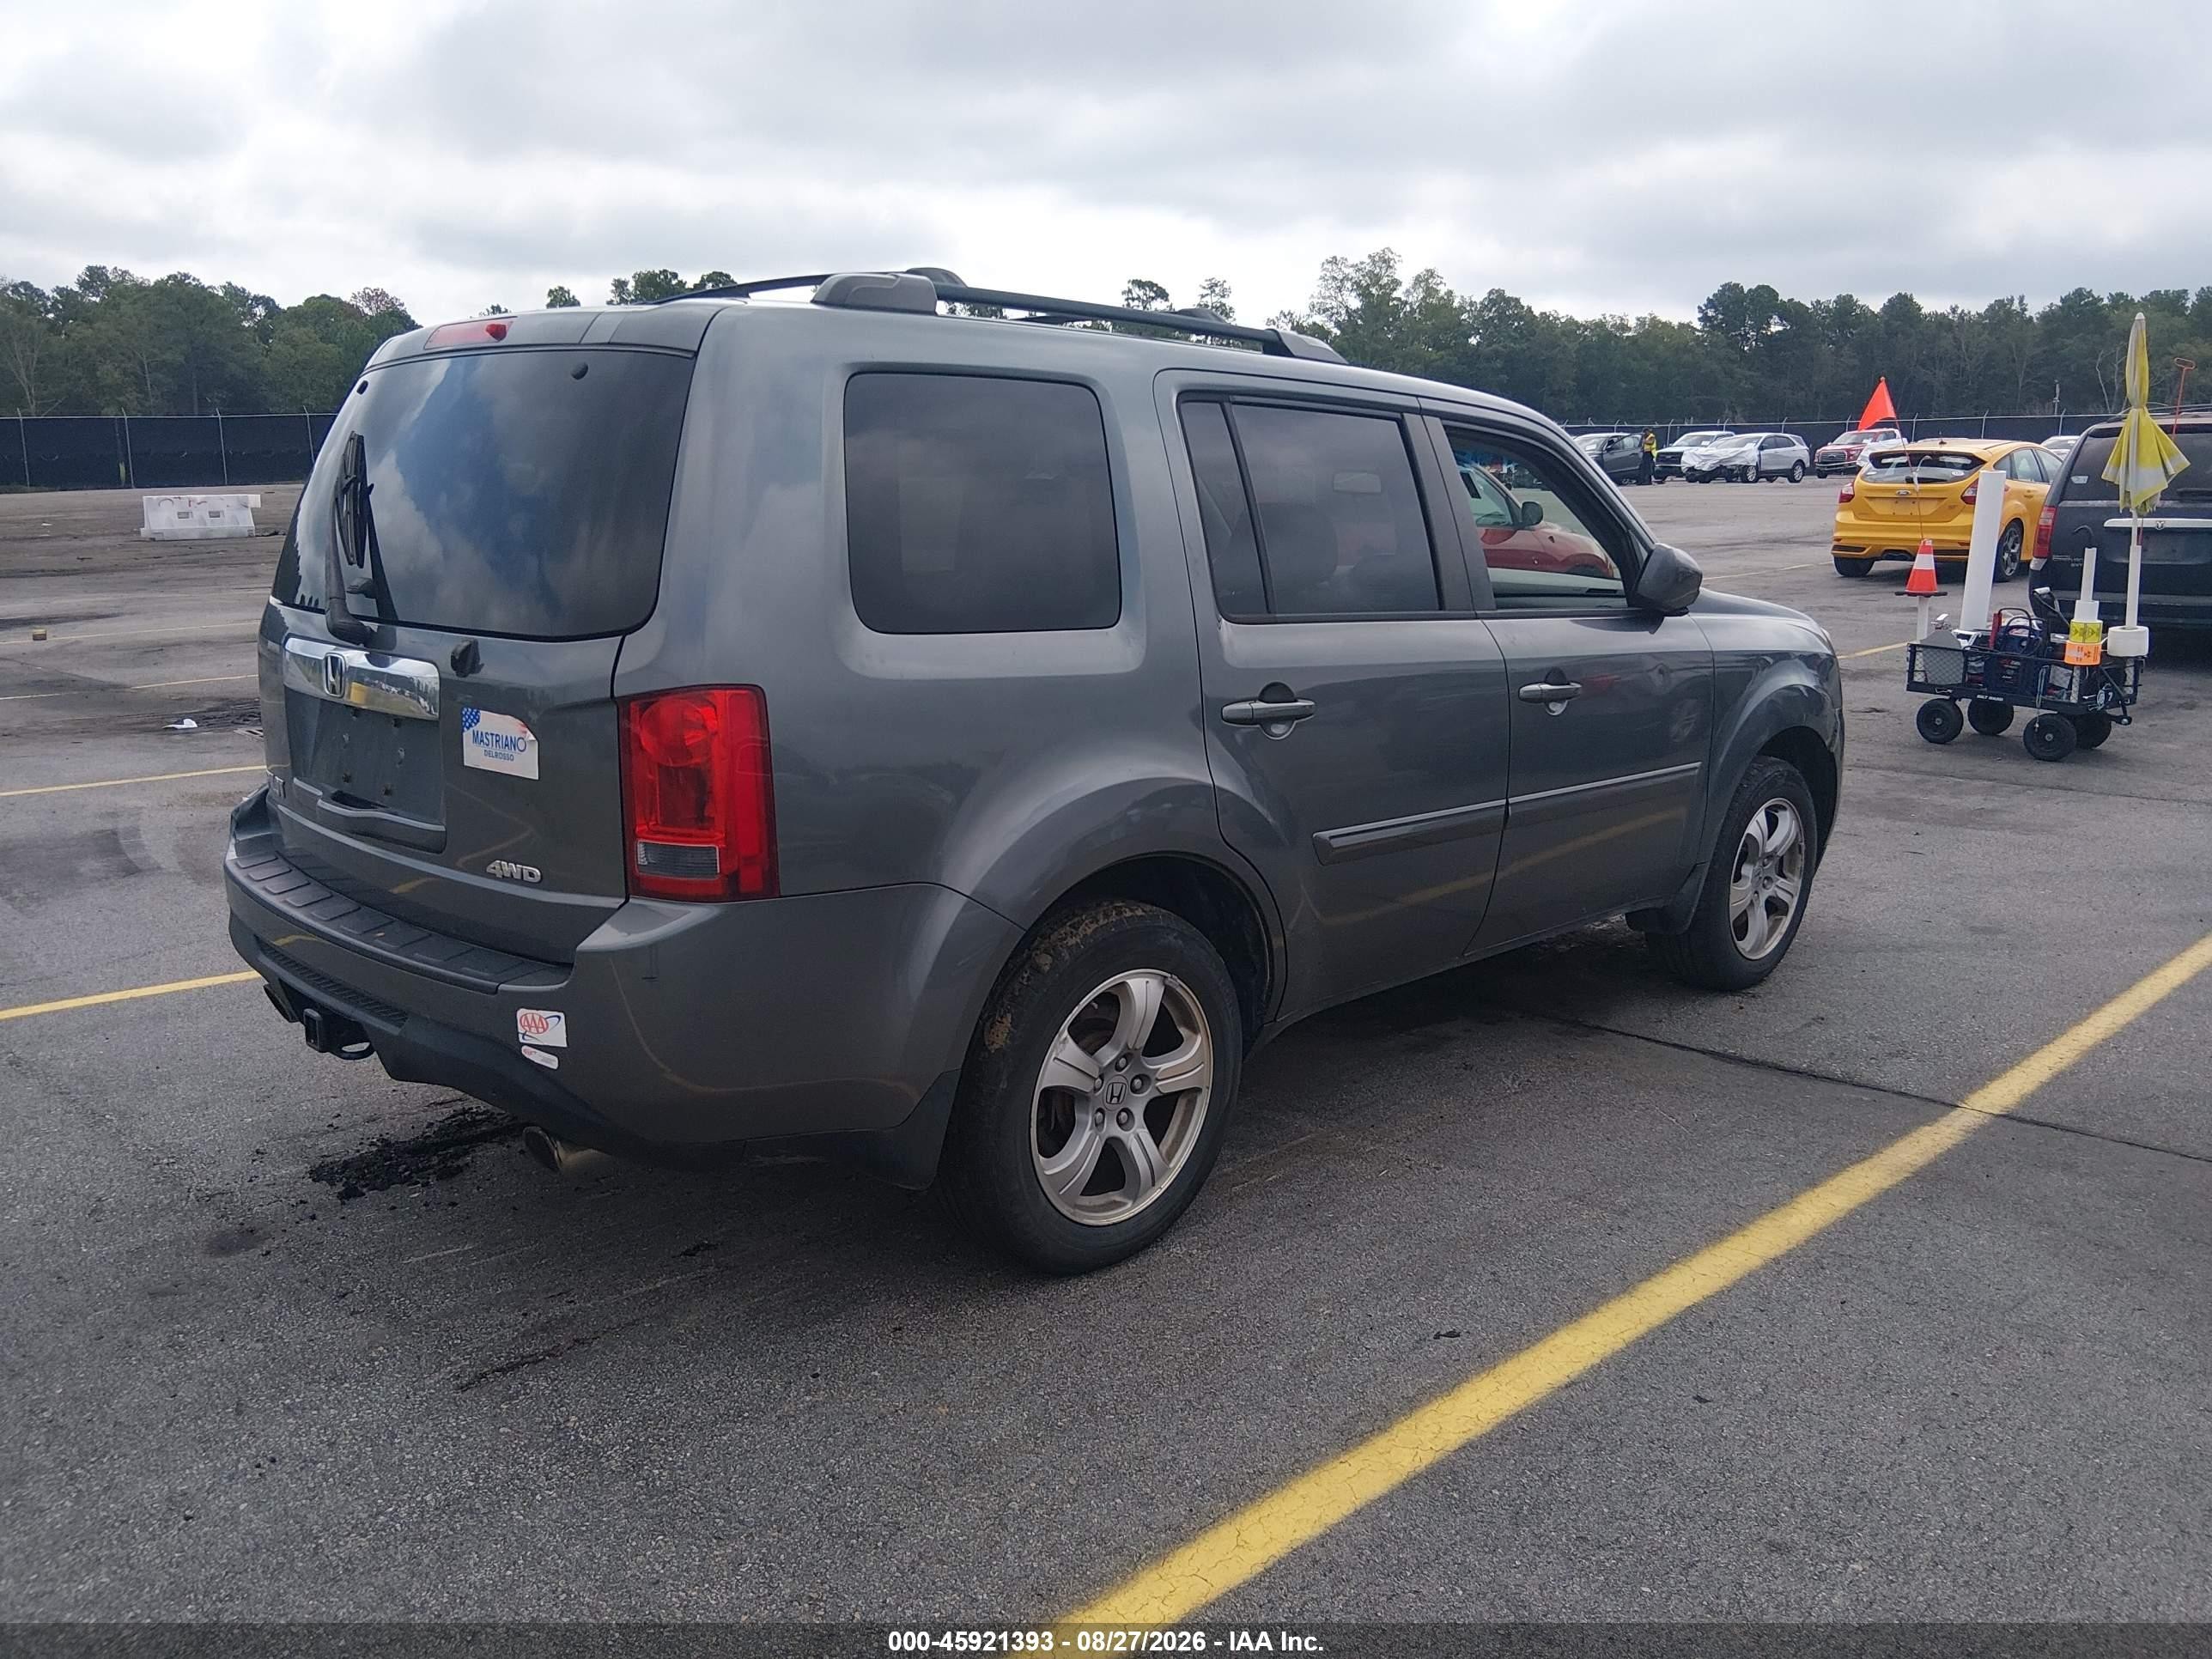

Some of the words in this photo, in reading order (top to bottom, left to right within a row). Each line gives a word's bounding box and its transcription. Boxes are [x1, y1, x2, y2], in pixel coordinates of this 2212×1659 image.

[472, 729, 527, 753] MASTRIANO
[483, 749, 514, 763] DELROSSO
[486, 860, 542, 884] 4WD
[520, 1013, 548, 1034] AAA
